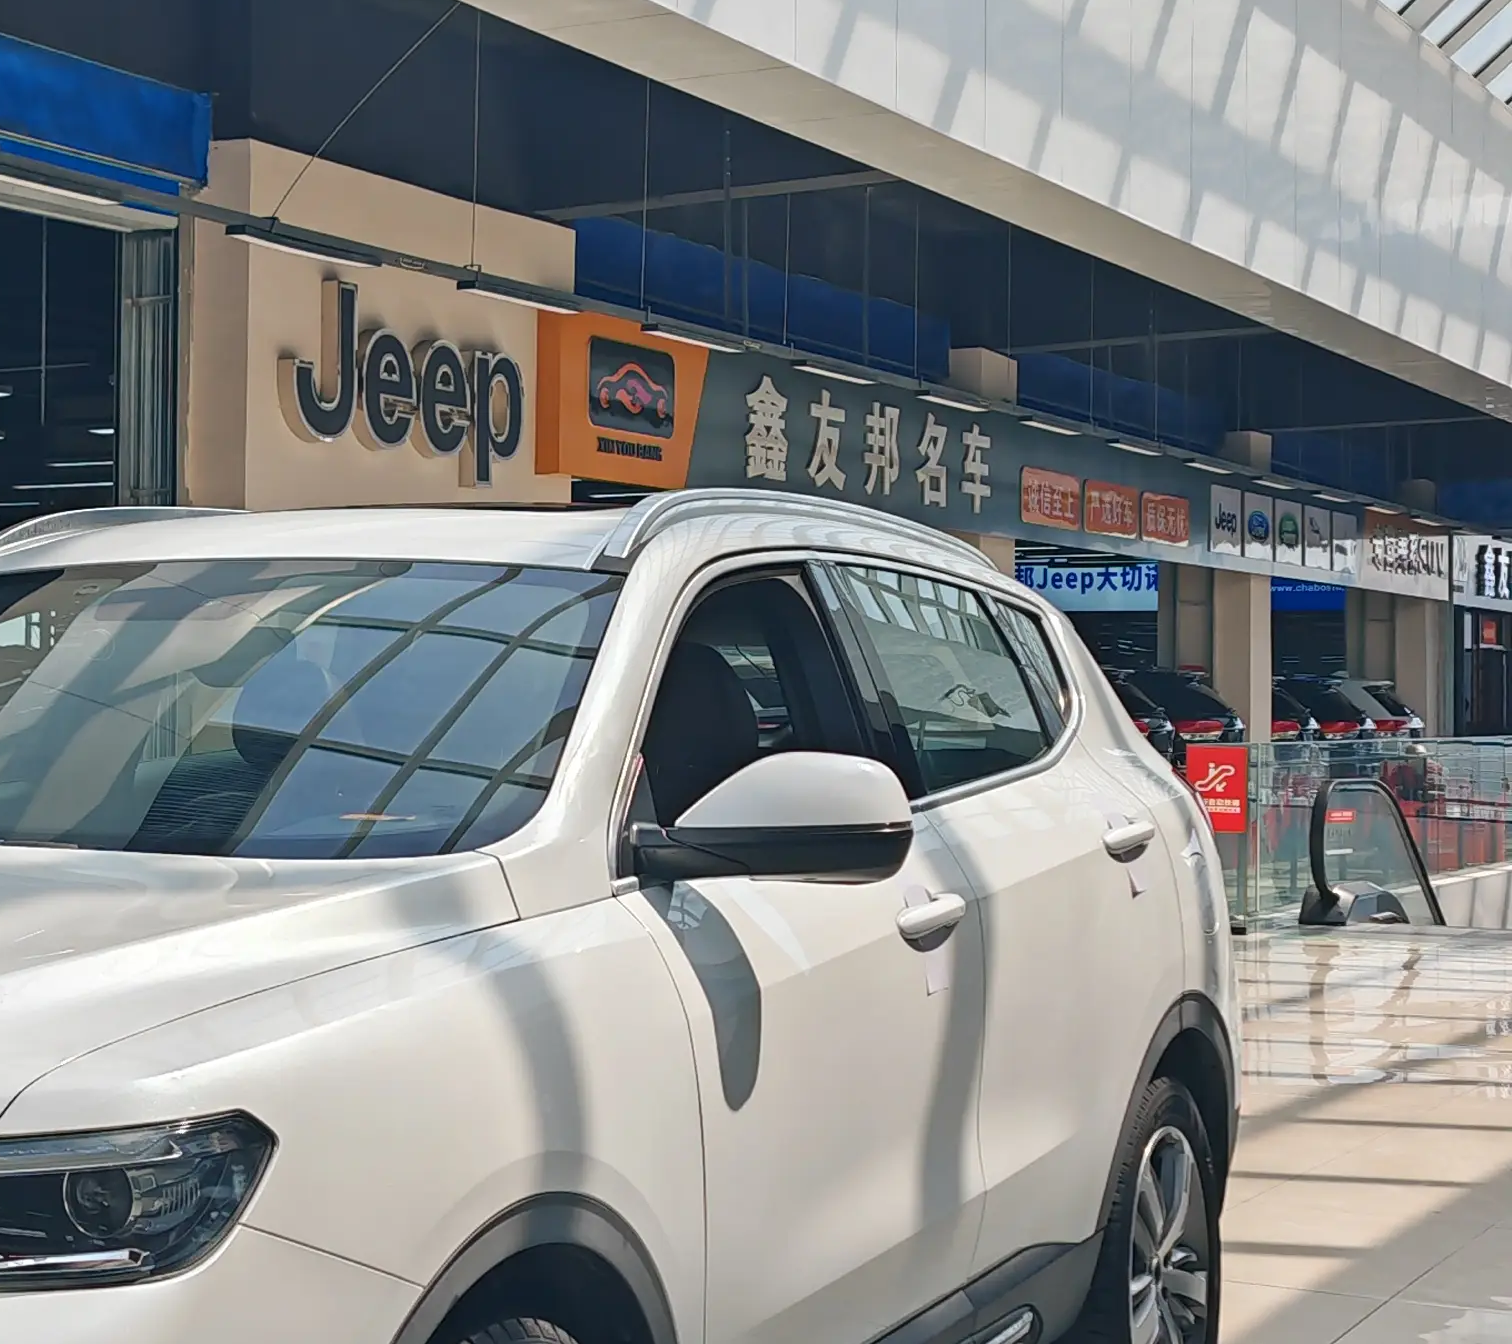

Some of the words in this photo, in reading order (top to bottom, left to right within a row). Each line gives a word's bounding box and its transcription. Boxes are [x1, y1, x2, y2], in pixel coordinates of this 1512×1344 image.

[282, 281, 525, 488] Jeep
[745, 375, 991, 514] 鑫友邦名车
[1215, 502, 1237, 538] Jeep
